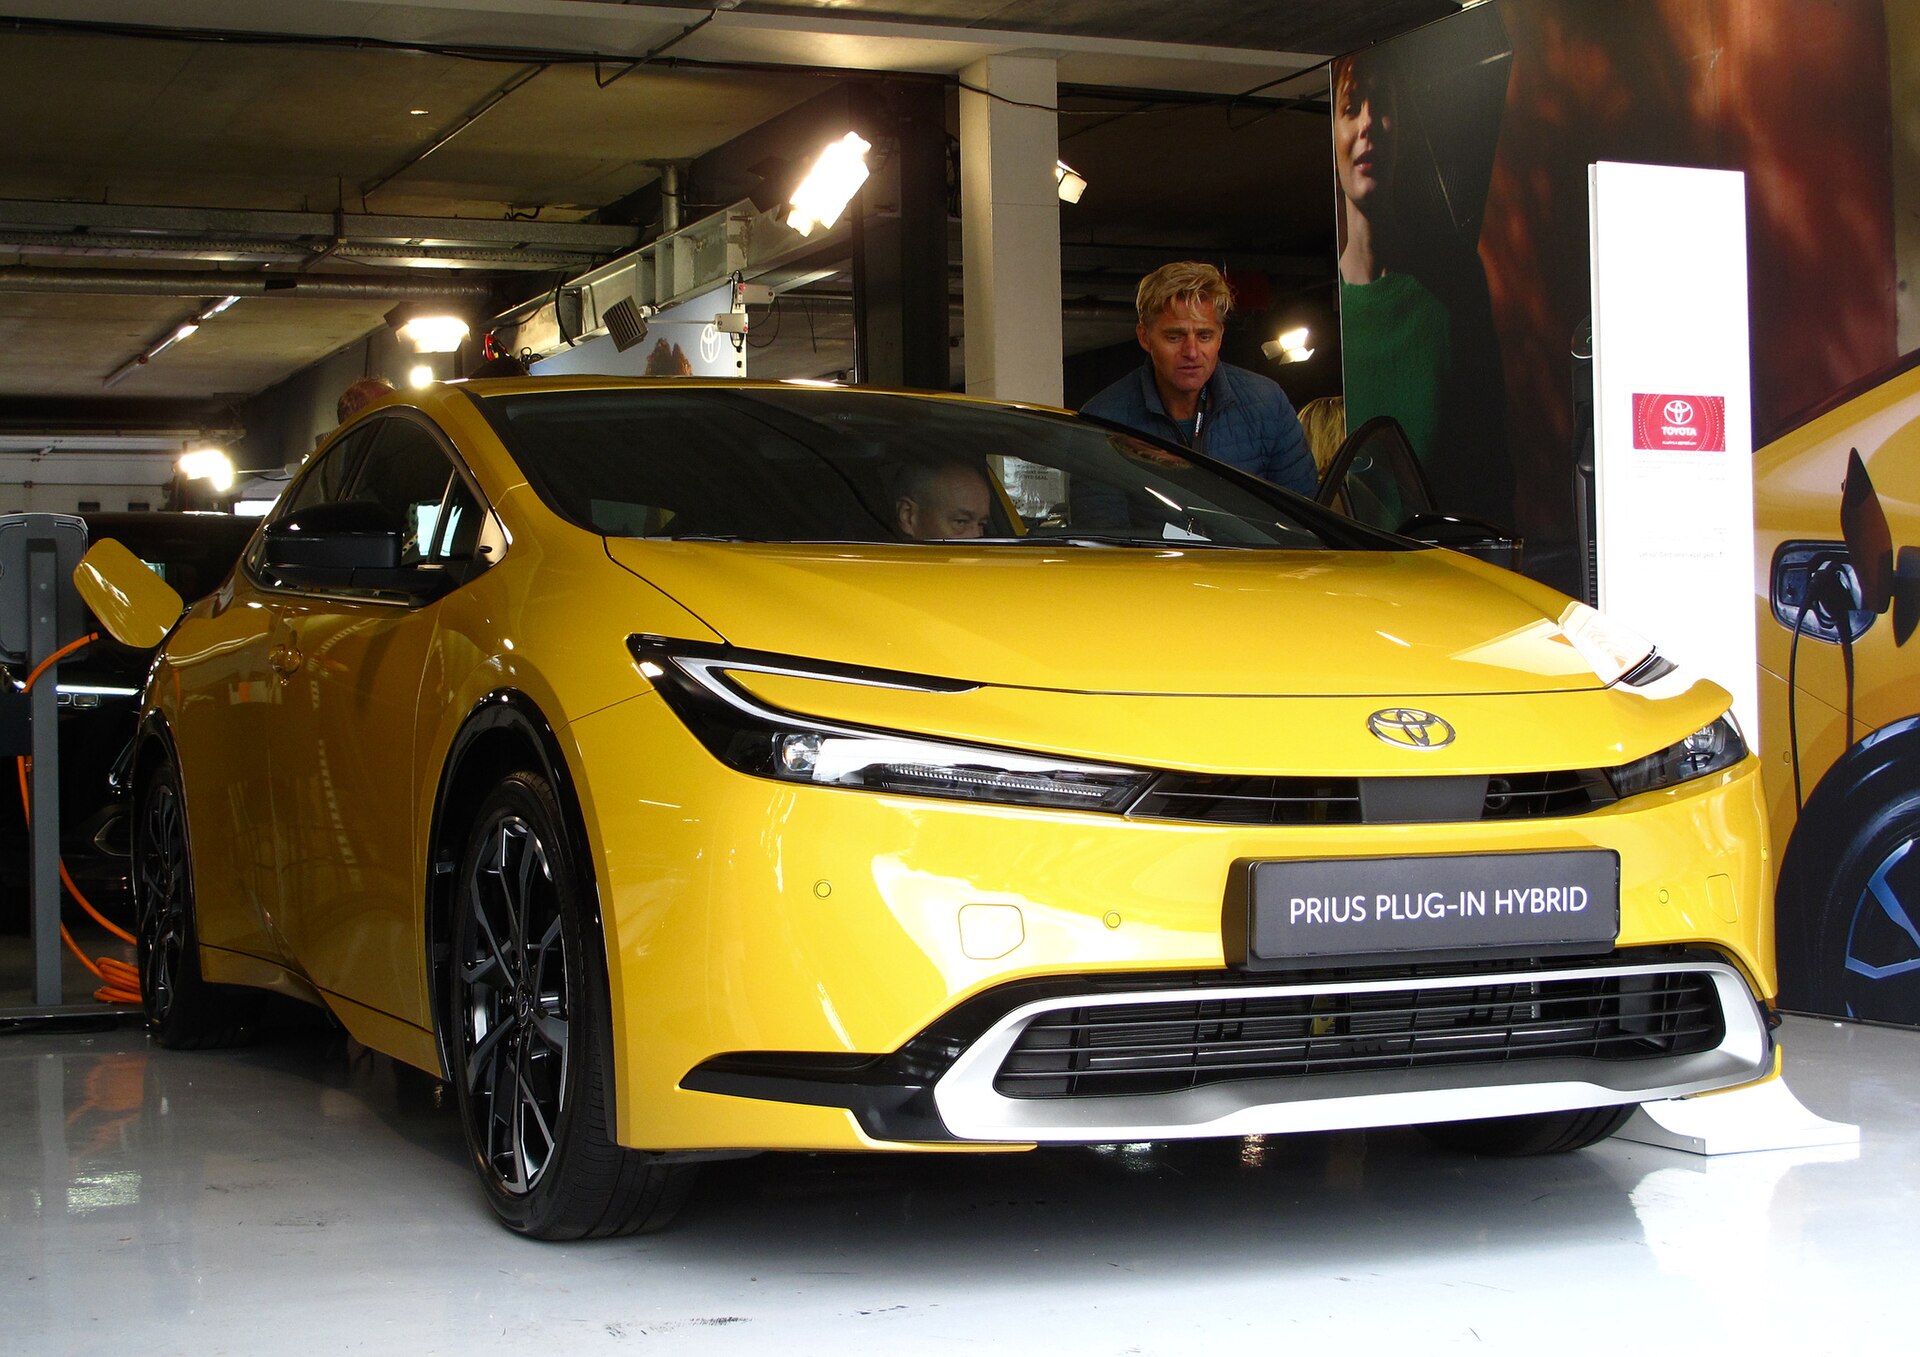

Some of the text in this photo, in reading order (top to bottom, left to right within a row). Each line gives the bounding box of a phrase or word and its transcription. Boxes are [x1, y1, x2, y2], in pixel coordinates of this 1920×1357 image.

[1661, 426, 1697, 436] TOYOTA
[1290, 886, 1588, 925] PRIUS PLUG-IN HYBRID
